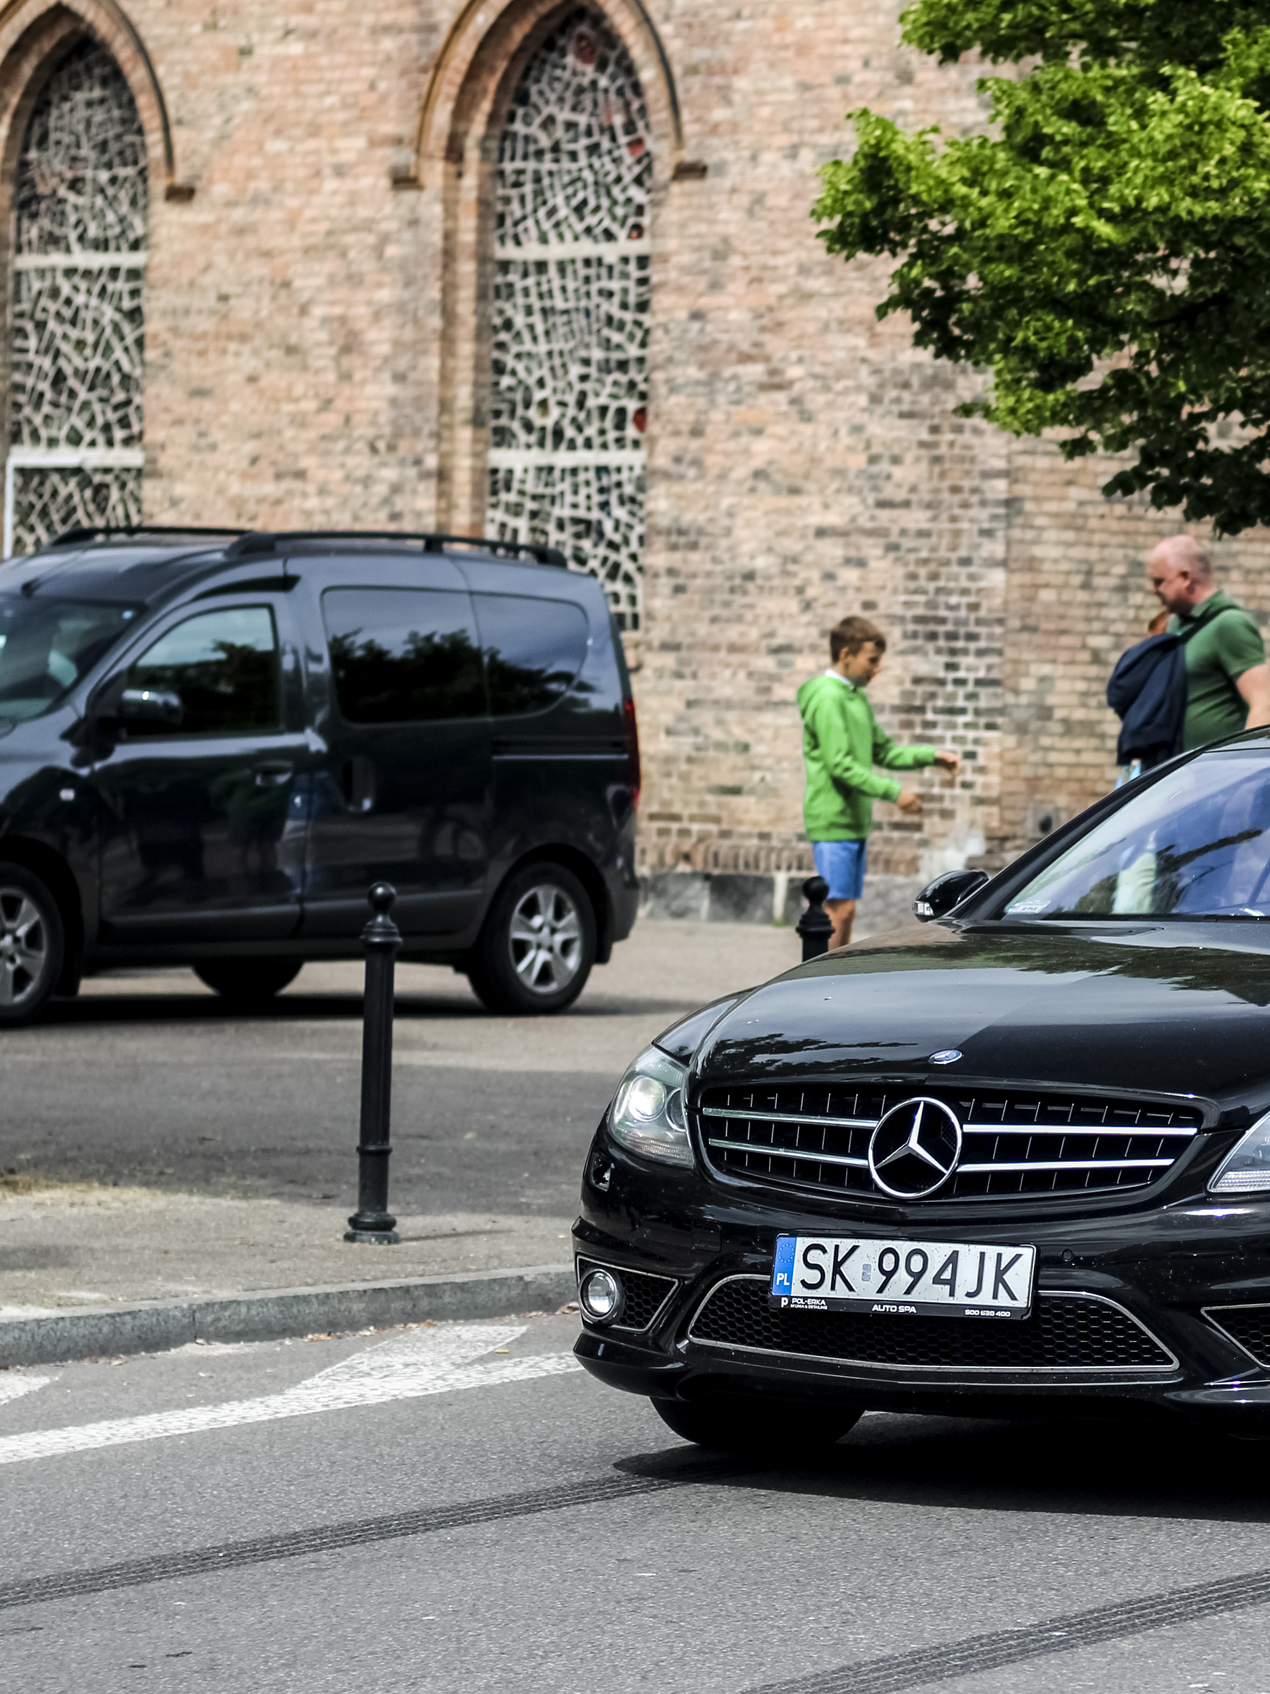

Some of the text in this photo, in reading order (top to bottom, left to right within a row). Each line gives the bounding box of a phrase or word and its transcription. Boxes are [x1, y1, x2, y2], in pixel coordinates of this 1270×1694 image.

[776, 1272, 790, 1286] PL
[800, 1243, 1023, 1301] SK 994JK
[872, 1304, 917, 1313] AUTO SPA
